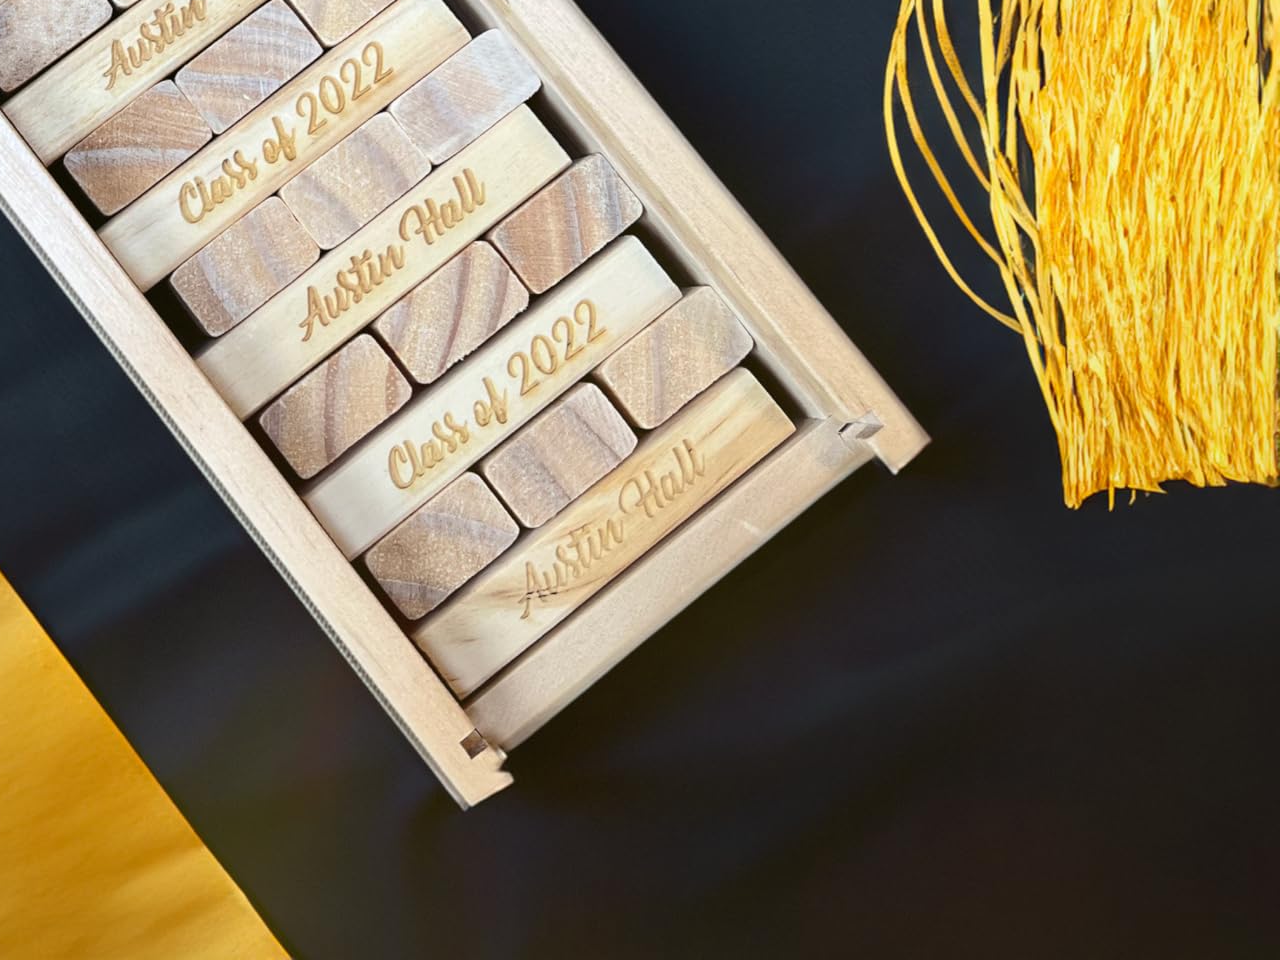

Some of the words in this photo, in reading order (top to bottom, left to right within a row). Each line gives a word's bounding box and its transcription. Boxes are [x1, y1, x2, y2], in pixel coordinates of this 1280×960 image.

[177, 148, 258, 224] Class
[262, 115, 297, 164] of
[294, 40, 395, 135] 2022
[298, 243, 405, 342] Austin
[398, 167, 488, 246] Hall
[387, 409, 472, 490] Class
[473, 376, 510, 426] of
[506, 298, 609, 397] 2022
[518, 517, 625, 619] Austin
[617, 436, 707, 518] Hall
